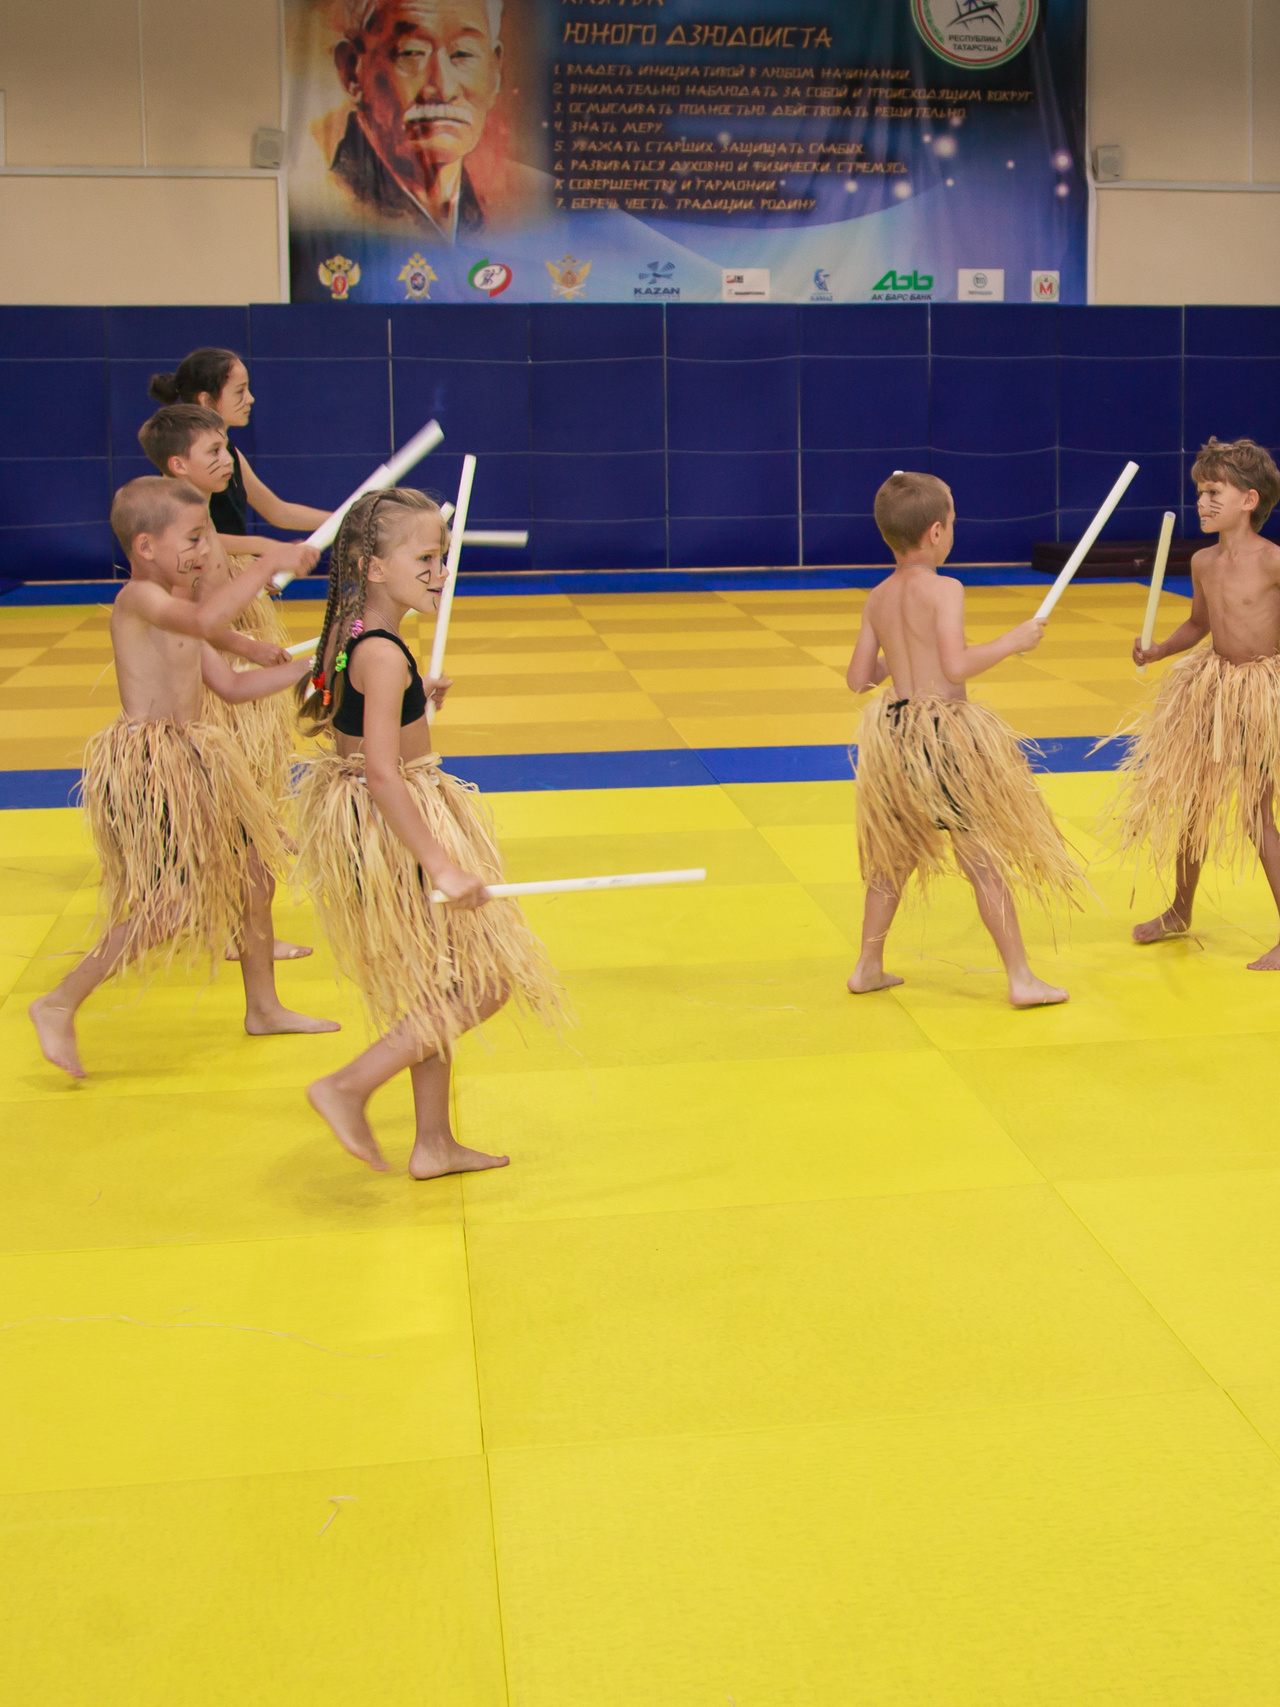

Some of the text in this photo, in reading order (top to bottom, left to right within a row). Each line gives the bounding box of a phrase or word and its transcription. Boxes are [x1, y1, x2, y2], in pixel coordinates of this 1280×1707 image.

[563, 22, 834, 48] ЮНОГО ДЗЮДОИСТА
[948, 34, 1003, 43] РЕСПУБЛИКА
[953, 43, 998, 52] ТАТАРСТАН
[567, 64, 633, 76] ВЛАДЕТЬ
[639, 64, 745, 80] ИНИЦИАТИВОЙ
[750, 66, 757, 79] В
[761, 66, 814, 79] ЛЮБОМ
[569, 83, 681, 96] ВНИМАТЕЛЬНО
[685, 84, 778, 98] НАБЛЮДАТЬ
[782, 86, 801, 98] ЗА
[806, 85, 849, 98] СОБОЙ
[852, 88, 862, 98] И
[867, 87, 982, 103] ПРОИСХОДЯЩИМ
[568, 102, 674, 115] ОСМЫСЛИВАТЬ
[771, 103, 869, 118] ДЕЙСТВОВАТЬ
[570, 121, 617, 133] ЗНАТЬ
[571, 140, 641, 153] УВАЖАТЬ
[720, 142, 805, 157] ЗАЩИЩАТЬ
[571, 159, 666, 172] РАЗВИВАТЬСЯ
[670, 160, 734, 172] ДУХОВНО
[737, 161, 748, 172] И
[837, 162, 908, 174] СТРЕМЯСЬ
[555, 179, 566, 190] К
[568, 178, 678, 191] СОВЕРШЕНСТВУ
[681, 179, 692, 191] И
[571, 198, 620, 210] БЕРЕЧЬ
[634, 287, 680, 295] KAZAN
[909, 293, 933, 302] БАНК
